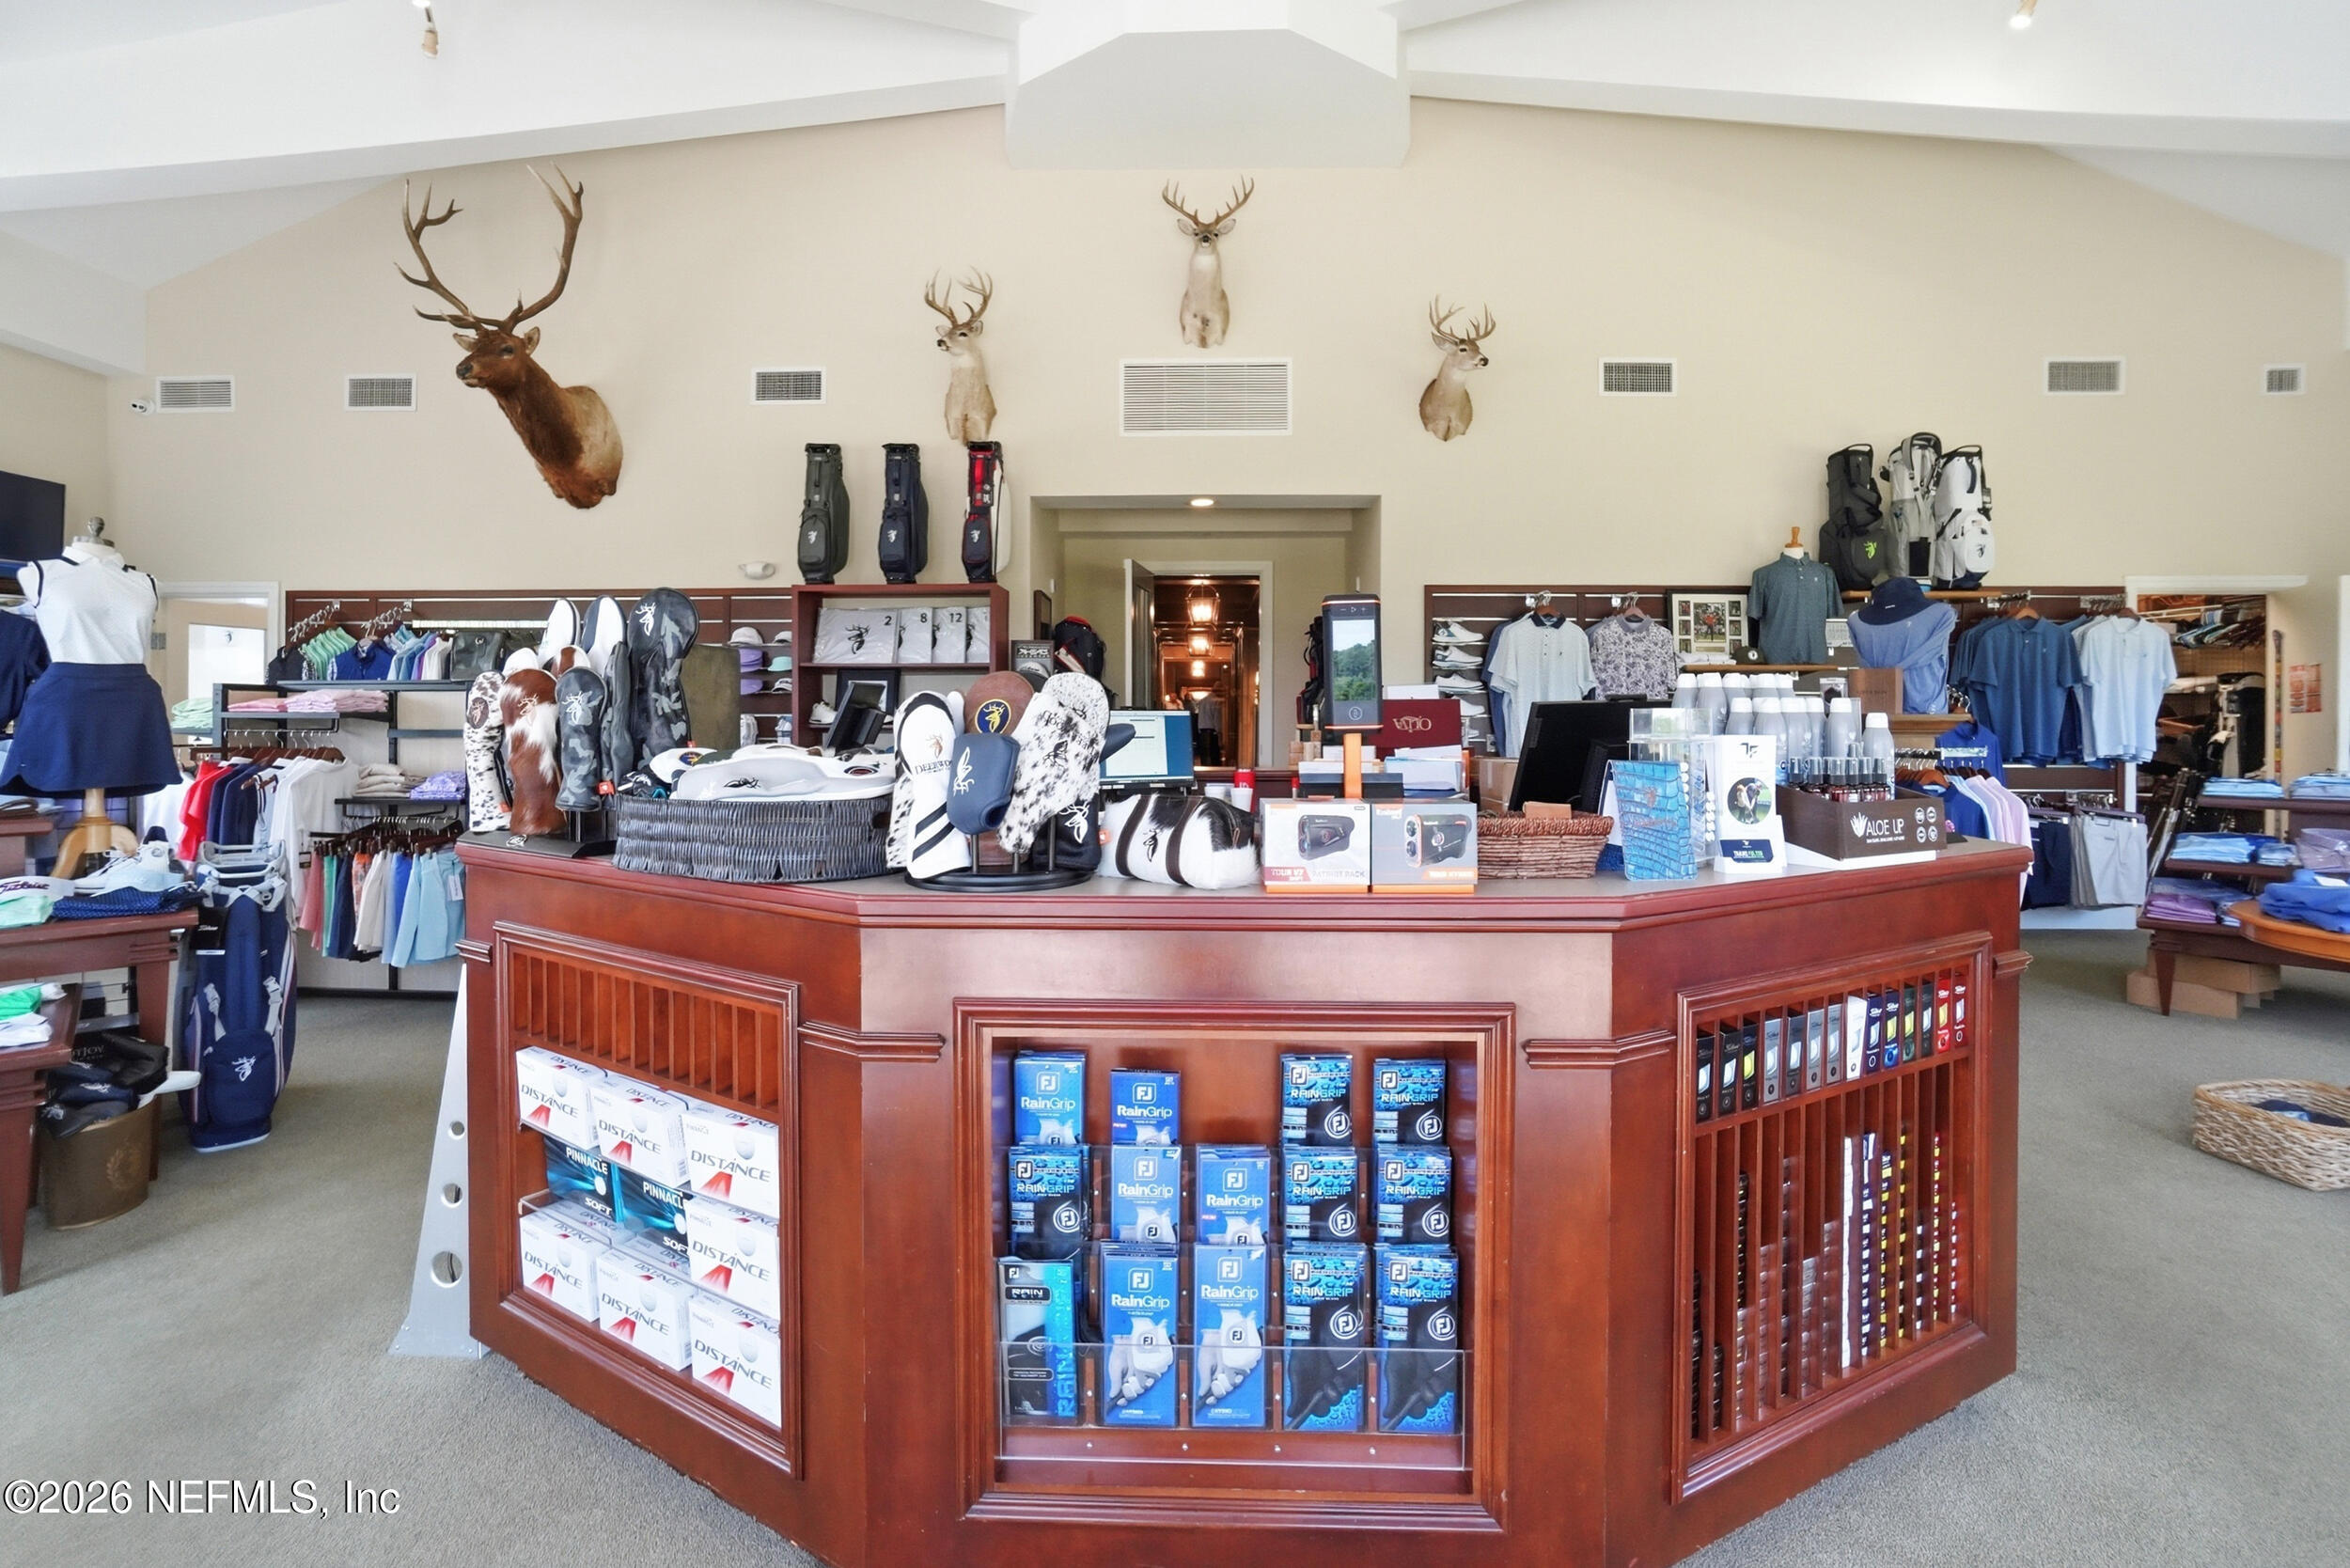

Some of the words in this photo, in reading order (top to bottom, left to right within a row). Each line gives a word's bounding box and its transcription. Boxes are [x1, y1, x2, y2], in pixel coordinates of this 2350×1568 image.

[884, 615, 892, 626] 2
[920, 612, 928, 623] 8
[948, 612, 963, 623] 12
[1866, 819, 1889, 837] ALOE
[1892, 818, 1904, 834] UP
[1041, 1075, 1057, 1090] FJ
[1292, 1069, 1307, 1084] FJ
[1383, 1073, 1397, 1089] FJ
[521, 1083, 579, 1119] DISTANCE
[1136, 1086, 1152, 1101] FJ
[1021, 1096, 1076, 1112] RainGrip
[1117, 1105, 1173, 1119] RainGrip
[1332, 1115, 1346, 1130] FJ
[1423, 1119, 1438, 1134] FJ
[599, 1119, 662, 1154] DISTANCE
[566, 1146, 608, 1175] PINNACLE
[691, 1149, 772, 1183] DISTANCE
[1017, 1162, 1032, 1178] FJ
[1138, 1161, 1153, 1177] FJ
[1293, 1166, 1308, 1181] FJ
[1386, 1165, 1402, 1180] FJ
[1227, 1172, 1243, 1188] FJ
[643, 1181, 684, 1209] PINNACL
[1118, 1183, 1174, 1198] RainGrip
[585, 1197, 612, 1215] SOFT
[1206, 1194, 1263, 1209] RainGrip
[1059, 1211, 1075, 1226] FJ
[1337, 1214, 1352, 1229] FJ
[1430, 1214, 1444, 1230] FJ
[1147, 1226, 1158, 1238] FJ
[1237, 1235, 1247, 1244] FJ
[693, 1240, 771, 1281] DISTANCE
[524, 1250, 583, 1290] DISTANCE
[1009, 1267, 1019, 1278] FJ
[1222, 1262, 1238, 1278] FJ
[1294, 1262, 1308, 1279] FJ
[1391, 1262, 1407, 1279] FJ
[1132, 1274, 1149, 1290] FJ
[1201, 1285, 1259, 1301] RainGrip
[1111, 1294, 1169, 1309] RainGrip
[602, 1293, 670, 1336] DISTANCE
[1338, 1316, 1354, 1332] FJ
[1435, 1317, 1450, 1334] FJ
[1143, 1336, 1153, 1346] FJ
[1232, 1330, 1243, 1341] FJ
[694, 1339, 773, 1390] DISTANCE
